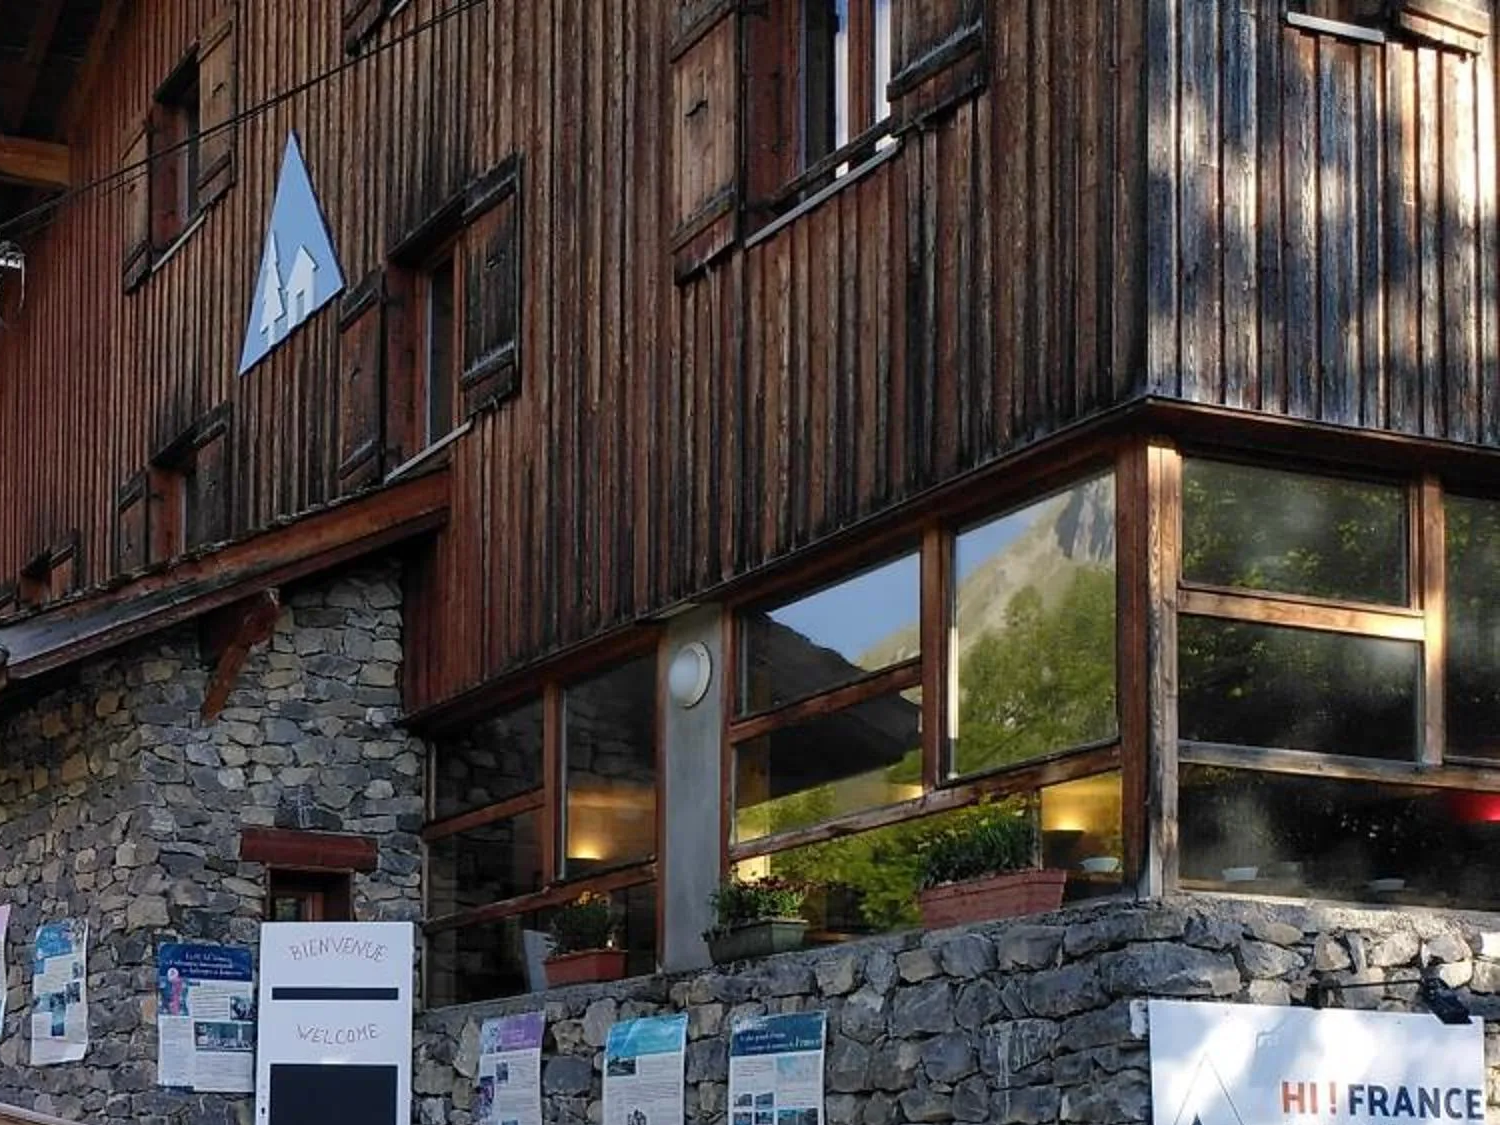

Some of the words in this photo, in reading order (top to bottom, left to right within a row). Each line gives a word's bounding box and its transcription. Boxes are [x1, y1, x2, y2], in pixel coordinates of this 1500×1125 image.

[289, 937, 387, 962] BIENVENUE
[297, 1023, 378, 1045] WELCOME
[1348, 1084, 1485, 1120] FRANCE
